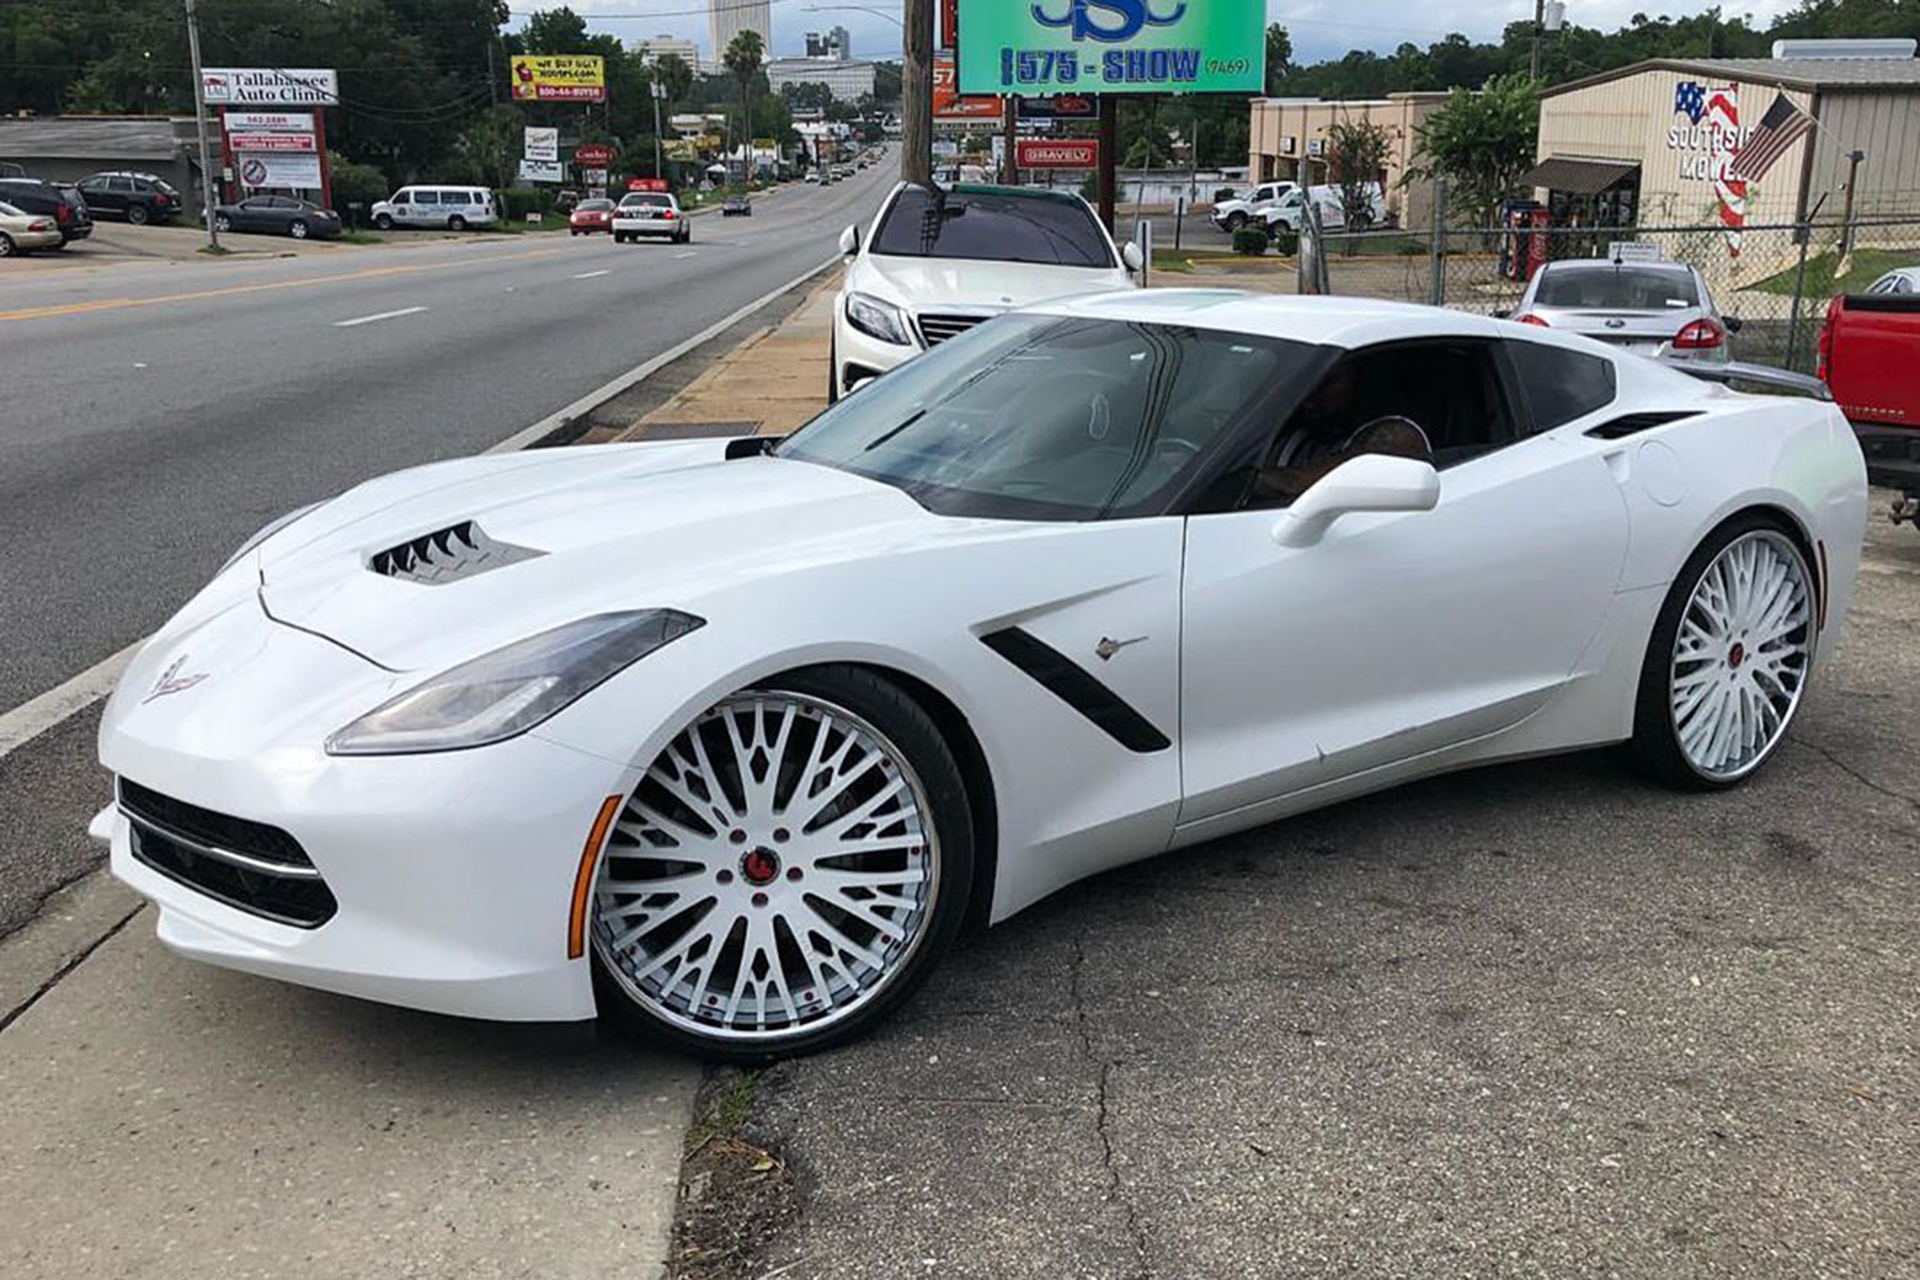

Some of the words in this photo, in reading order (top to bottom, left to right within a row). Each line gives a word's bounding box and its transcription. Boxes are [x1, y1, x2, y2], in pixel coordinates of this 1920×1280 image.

[1204, 59, 1249, 74] (7469)
[231, 73, 328, 86] Tallahassee
[235, 88, 276, 101] Auto
[280, 88, 328, 101] Clinic
[1667, 126, 1755, 150] SOUTHSI
[1026, 147, 1089, 161] GRAVELY
